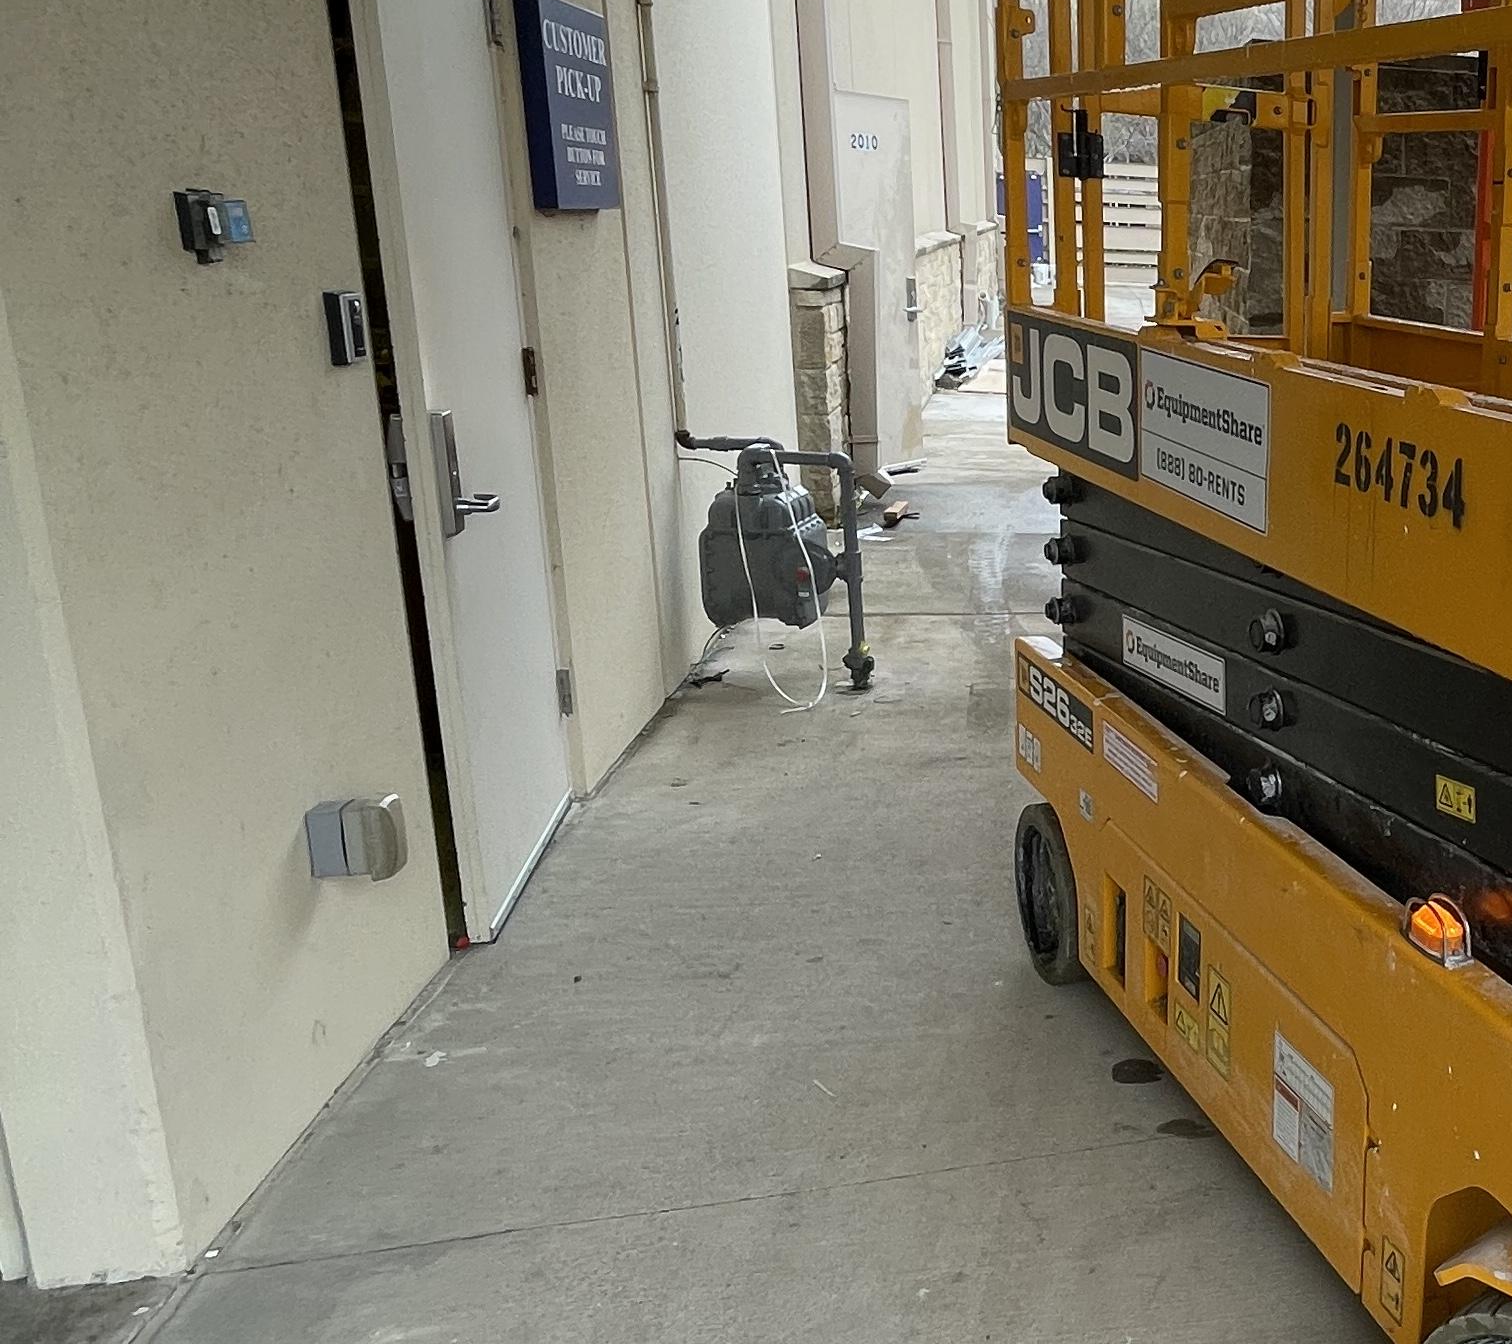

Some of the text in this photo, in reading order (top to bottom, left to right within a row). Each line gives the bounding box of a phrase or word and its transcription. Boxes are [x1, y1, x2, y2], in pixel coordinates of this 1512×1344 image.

[543, 19, 607, 66] CUSTOMER
[556, 65, 602, 103] PICK-UP
[850, 133, 879, 151] 2010
[1013, 328, 1134, 462] JCB
[1157, 387, 1263, 446] EquipmentShare
[1156, 447, 1246, 506] (888) 80-RENTS
[1335, 422, 1466, 529] 264734
[1136, 636, 1219, 693] EquipmentShare
